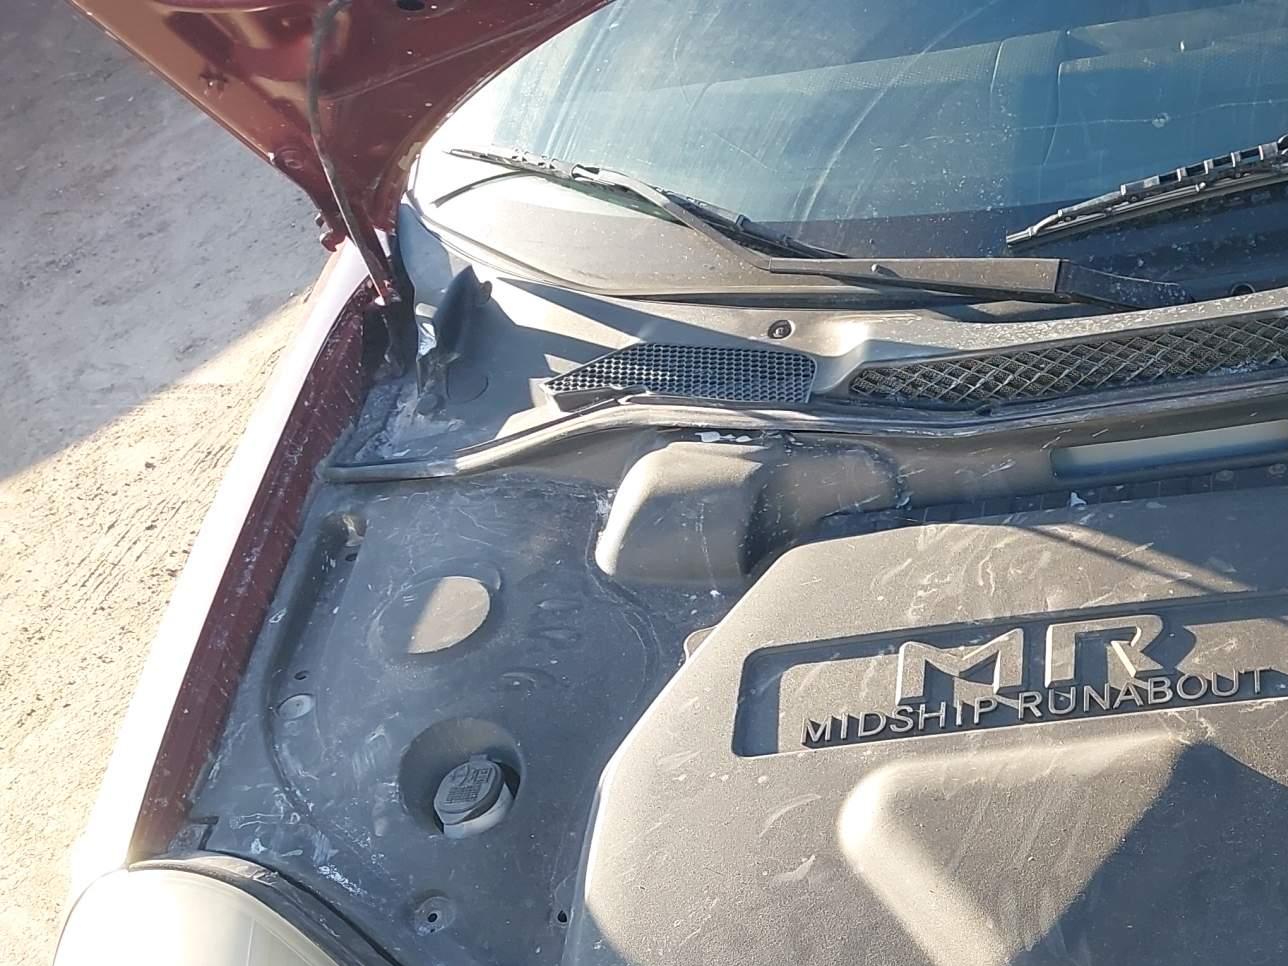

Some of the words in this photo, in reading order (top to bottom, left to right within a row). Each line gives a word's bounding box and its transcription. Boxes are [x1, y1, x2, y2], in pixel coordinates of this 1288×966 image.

[897, 614, 1170, 703] MR
[800, 696, 999, 745] MIDSHIP
[1017, 667, 1268, 719] RUNABOUT
